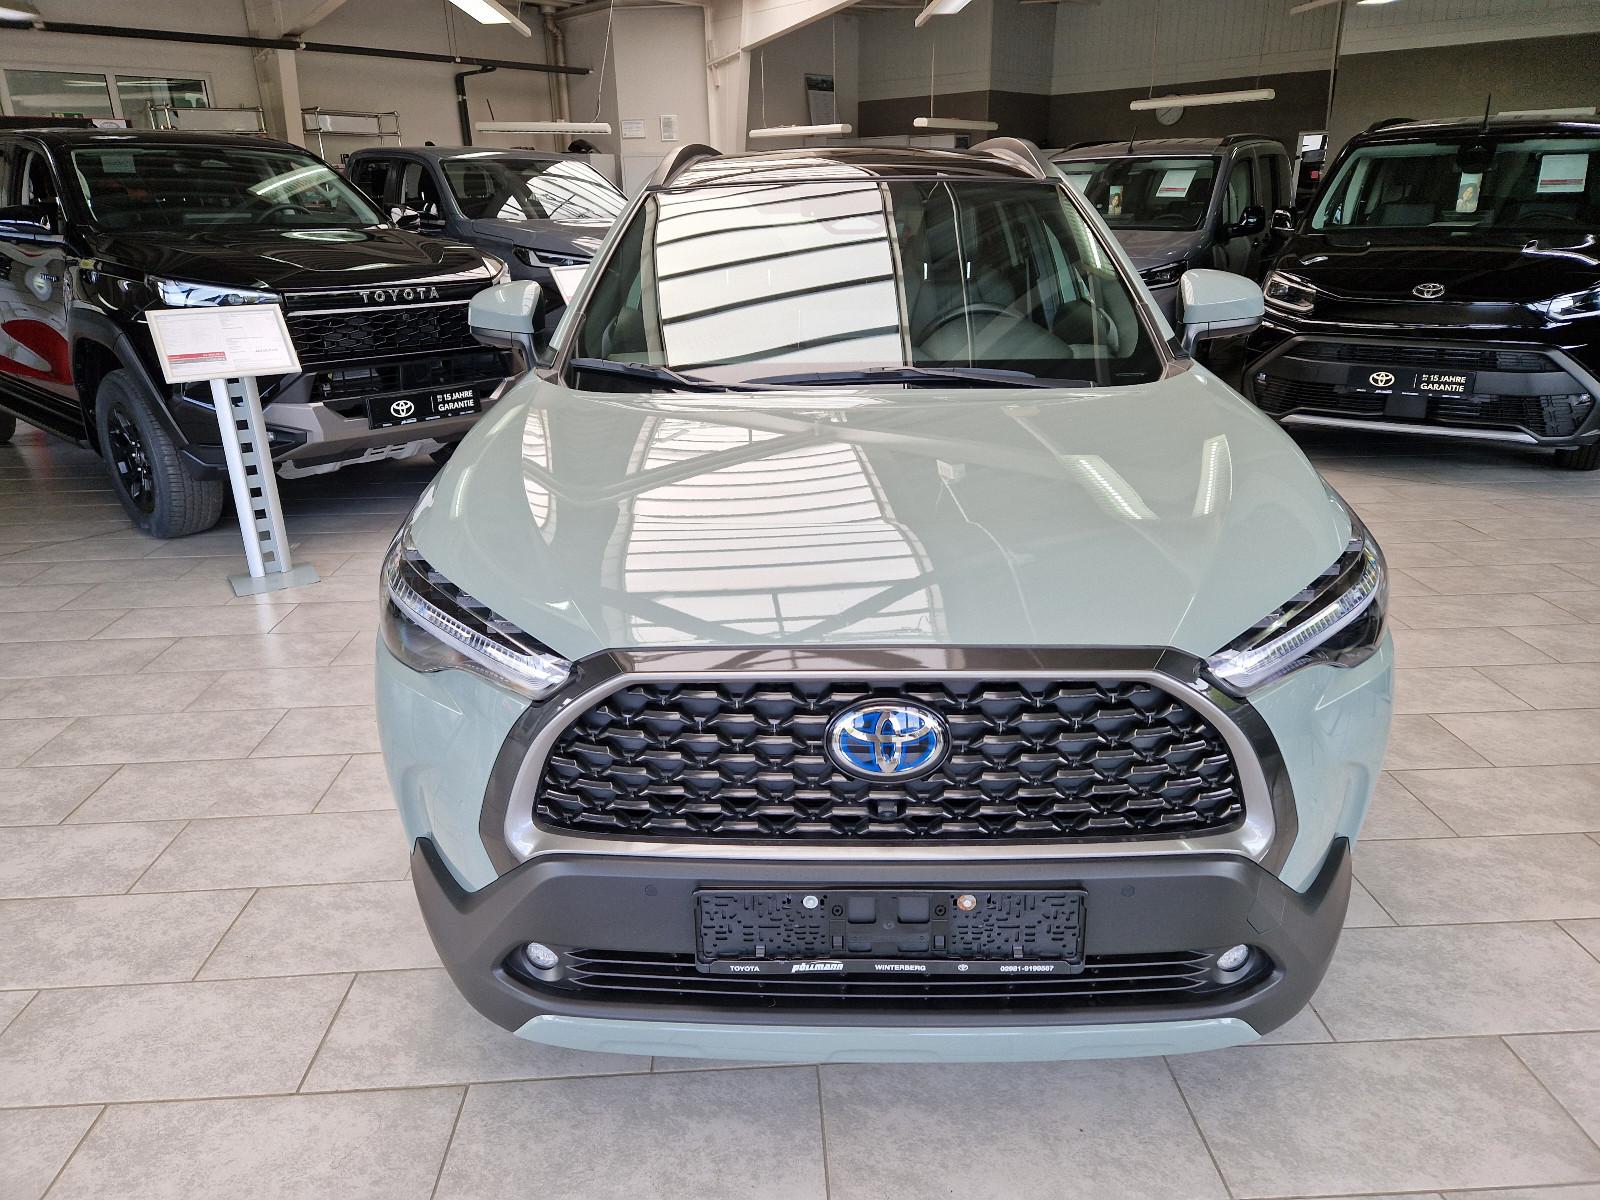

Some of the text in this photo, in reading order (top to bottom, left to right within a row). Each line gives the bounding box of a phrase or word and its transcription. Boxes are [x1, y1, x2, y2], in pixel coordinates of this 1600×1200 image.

[359, 286, 440, 303] TOYOTA
[1430, 374, 1440, 382] 15
[1439, 375, 1467, 384] JAHRE
[1420, 383, 1465, 392] GARANTIE
[443, 393, 452, 401] 15
[452, 390, 473, 400] JAHRE
[438, 399, 475, 411] GARANTIE
[874, 964, 927, 972] WINTERBERG
